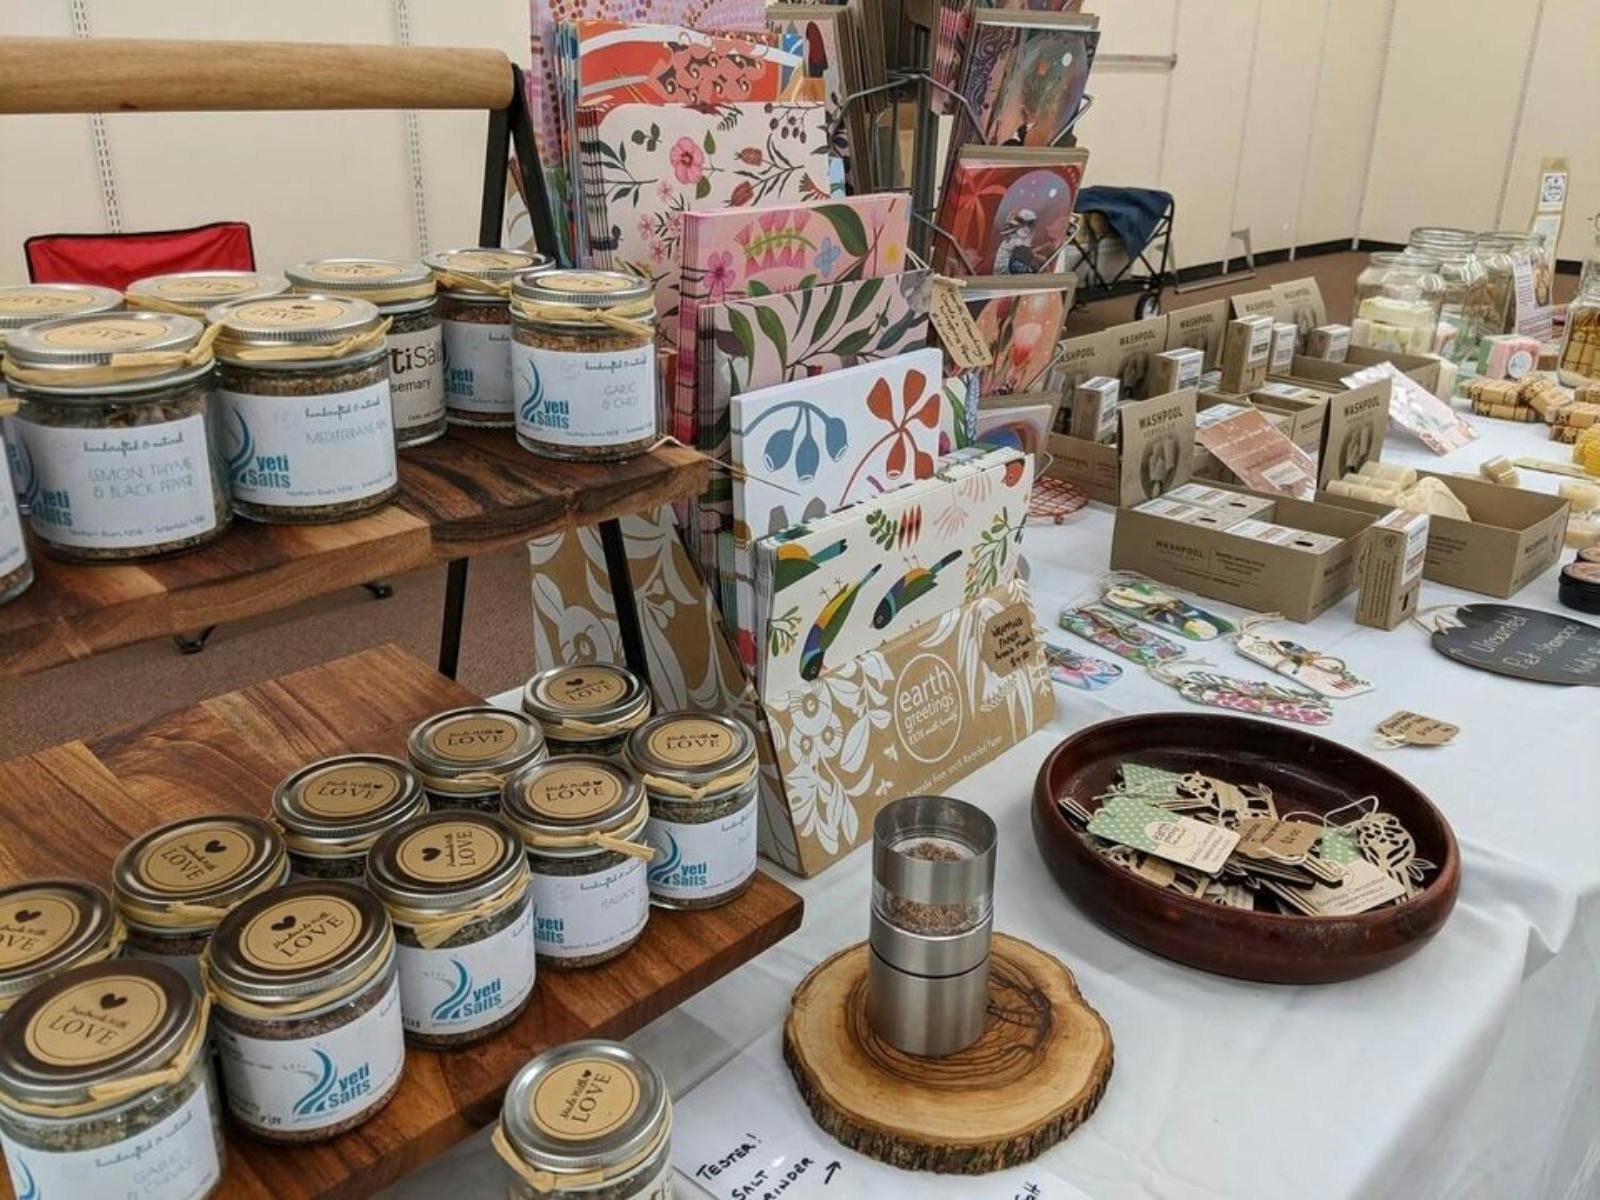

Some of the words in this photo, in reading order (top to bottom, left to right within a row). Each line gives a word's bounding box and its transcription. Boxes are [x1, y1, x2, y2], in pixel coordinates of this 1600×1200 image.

[391, 377, 431, 393] semary
[544, 399, 570, 416] yeti
[537, 410, 570, 430] Salts
[1138, 405, 1184, 430] WASHPOOL
[256, 454, 290, 473] yeti
[88, 466, 145, 484] LEMON
[248, 468, 291, 490] Salts
[111, 482, 155, 499] BLACK
[1155, 540, 1203, 559] WASHPOOL
[569, 683, 614, 702] LOVE
[900, 665, 950, 713] earth
[904, 692, 954, 735] greetings
[447, 734, 501, 747] LOVE
[665, 739, 721, 751] LOVE
[317, 785, 377, 801] LOVE
[545, 787, 605, 804] LOVE
[455, 830, 477, 867] LOVE
[160, 847, 205, 882] LOVE
[681, 861, 708, 876] yeti
[672, 873, 708, 888] Salts
[537, 917, 565, 932] yeti
[0, 933, 41, 951] VE
[281, 915, 345, 959] LOVE
[534, 928, 565, 944] alts
[473, 977, 501, 1002] yeti
[463, 993, 502, 1018] Salts
[48, 1014, 120, 1046] LOVE
[338, 1061, 370, 1092] yeti
[328, 1079, 371, 1109] Salts
[571, 1074, 612, 1124] LOVE
[731, 1167, 769, 1200] SALT
[763, 1156, 815, 1200] RINDER
